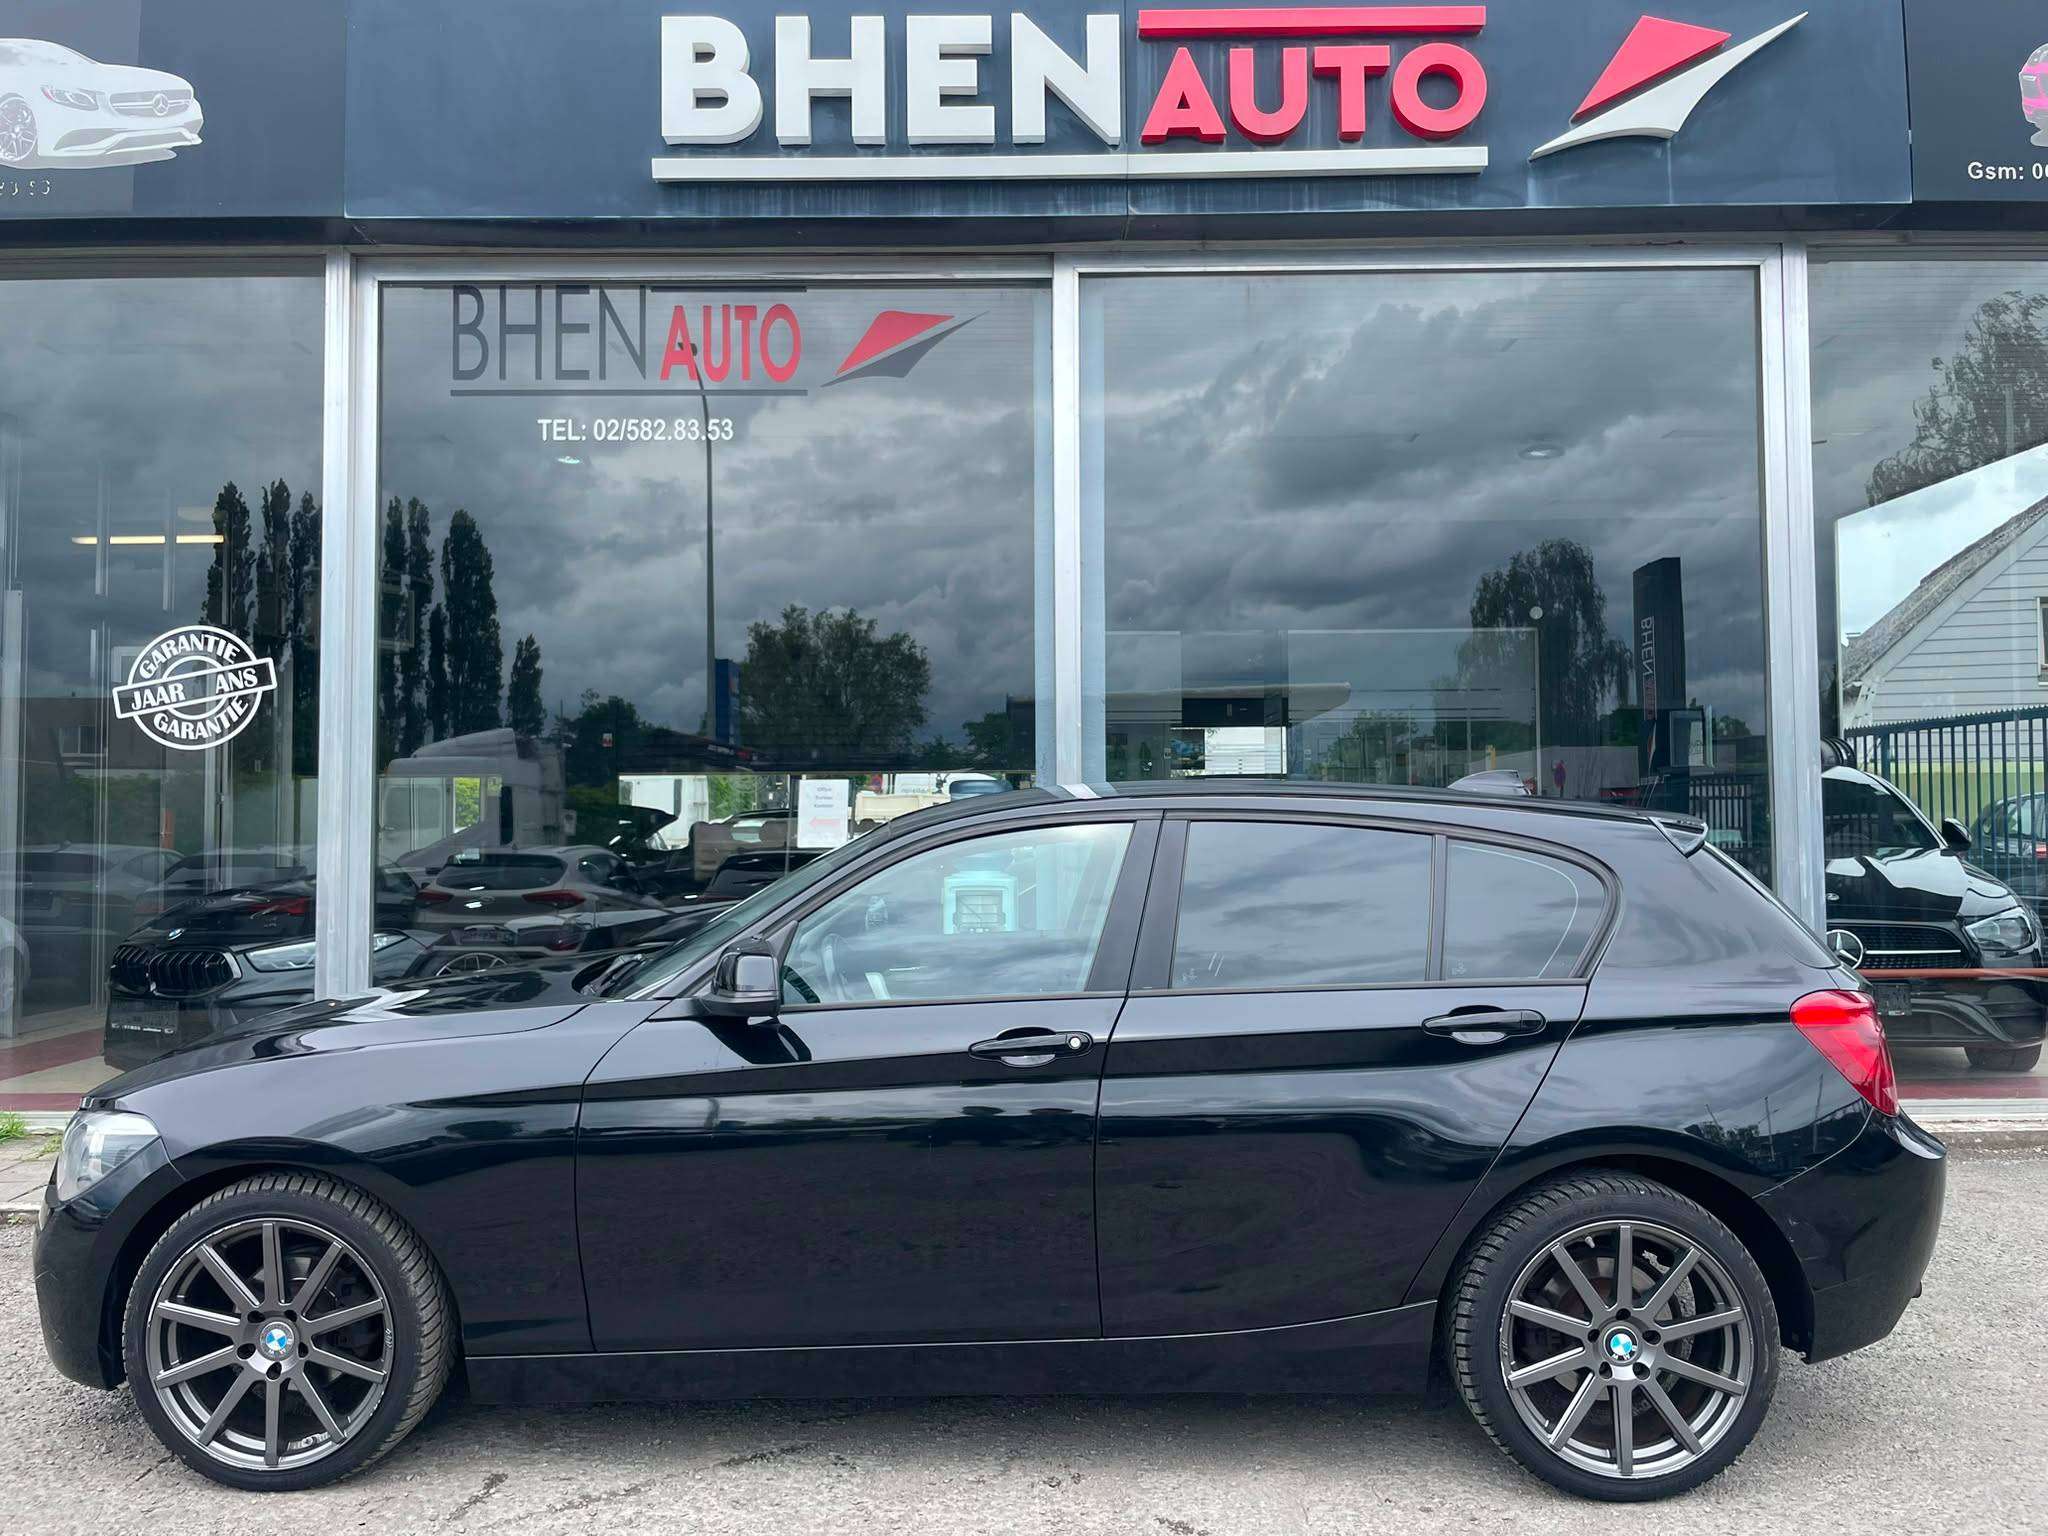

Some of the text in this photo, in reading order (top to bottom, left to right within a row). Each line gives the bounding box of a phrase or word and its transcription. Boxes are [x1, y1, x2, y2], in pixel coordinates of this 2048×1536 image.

[1967, 161, 2048, 180] Gsm: 0
[537, 418, 734, 442] TEL: 02/582.83.53
[139, 633, 240, 679] GARANTIE
[131, 668, 258, 710] JAAR ANS
[153, 695, 249, 740] GARANTIE
